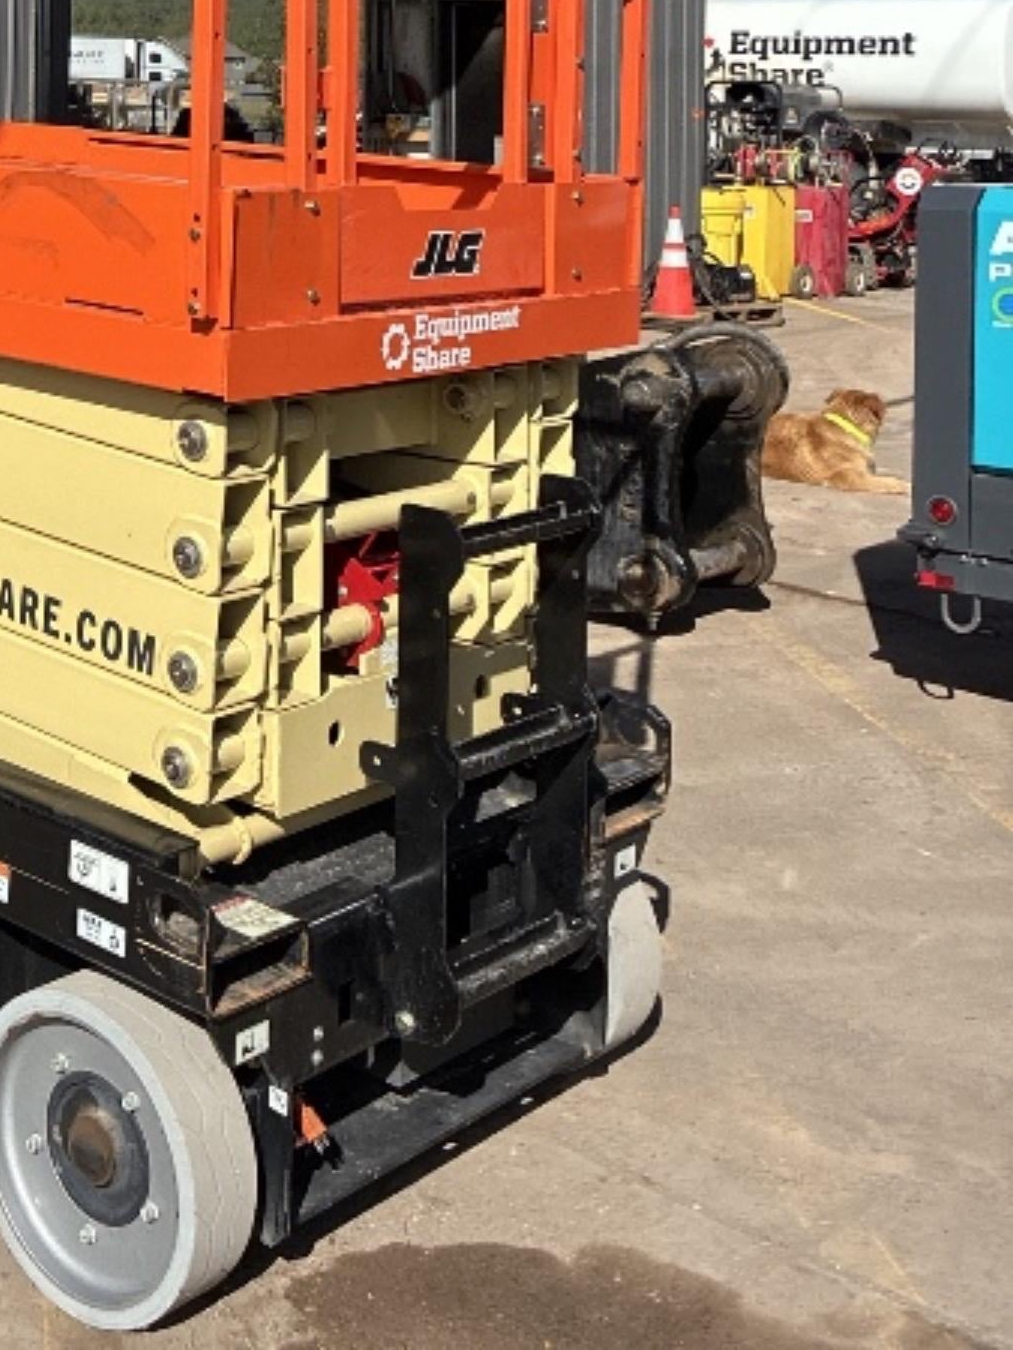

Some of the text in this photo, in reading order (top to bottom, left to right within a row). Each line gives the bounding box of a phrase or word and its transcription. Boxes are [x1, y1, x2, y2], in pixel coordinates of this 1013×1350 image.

[729, 30, 916, 61] Equipment
[728, 62, 826, 88] Share
[410, 228, 486, 280] JLG
[414, 305, 522, 343] Equipment
[412, 345, 472, 373] Share
